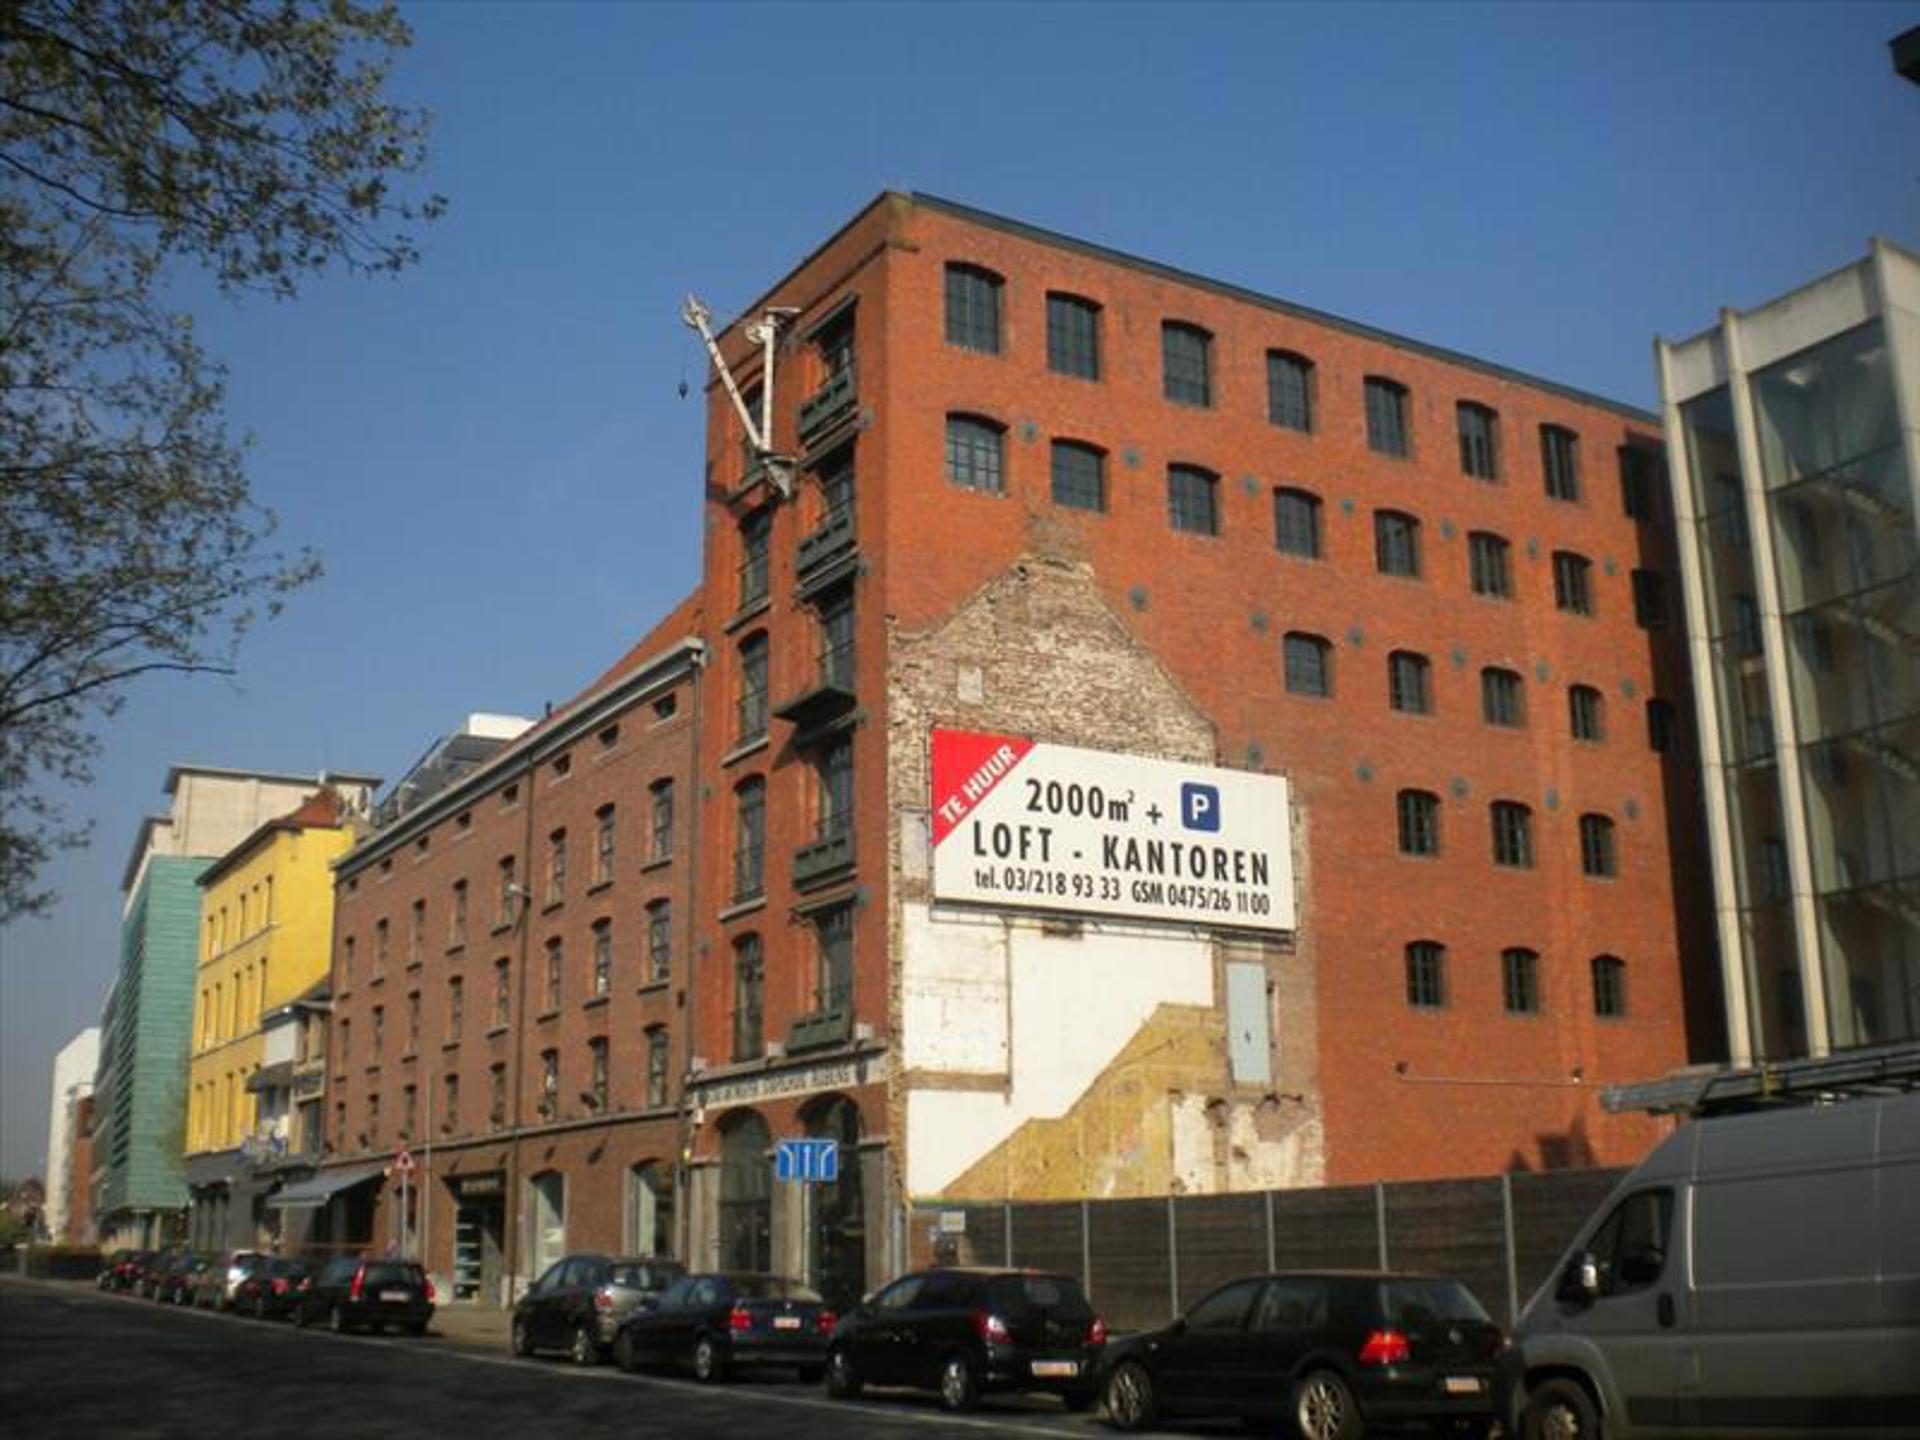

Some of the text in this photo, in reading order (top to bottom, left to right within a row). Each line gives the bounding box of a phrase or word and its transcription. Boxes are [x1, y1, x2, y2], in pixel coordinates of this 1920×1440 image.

[938, 745, 1017, 824] TE HUUR
[1145, 803, 1162, 824] +
[974, 820, 1052, 862] LOFT
[1103, 834, 1269, 886] KANTOREN
[975, 866, 1000, 889] tel.
[1004, 867, 1067, 895] 03/218
[1072, 873, 1094, 898] 93
[1100, 876, 1121, 900] 33
[1131, 880, 1164, 905] GSM
[1168, 883, 1231, 912] 0475/26
